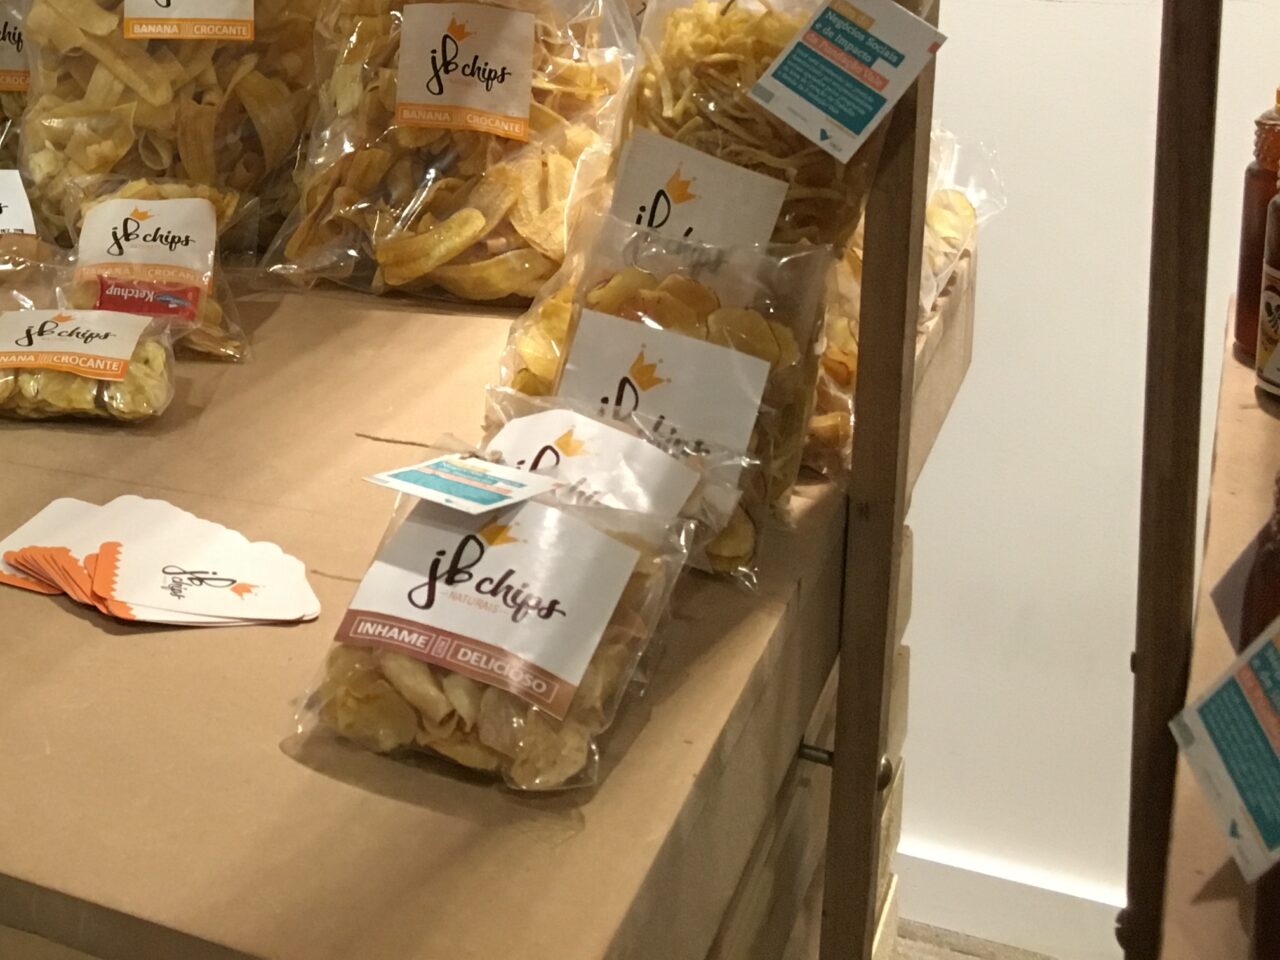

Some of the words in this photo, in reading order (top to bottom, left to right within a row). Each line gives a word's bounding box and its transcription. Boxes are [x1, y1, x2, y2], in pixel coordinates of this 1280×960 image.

[134, 24, 178, 33] BANANA
[194, 25, 248, 35] CROCANTE
[426, 34, 459, 95] jb
[461, 55, 511, 91] chips
[403, 109, 451, 121] BANANA
[467, 114, 521, 132] CROCANTE
[107, 217, 140, 256] jb
[143, 227, 196, 251] chips
[106, 285, 154, 301] Ketchup
[15, 320, 58, 347] jb
[57, 324, 117, 342] chips
[54, 356, 119, 371] CROCANTE
[408, 534, 485, 610] jb
[475, 569, 566, 623] chips
[357, 621, 429, 649] INHAME
[457, 647, 547, 694] DELICIOSO
